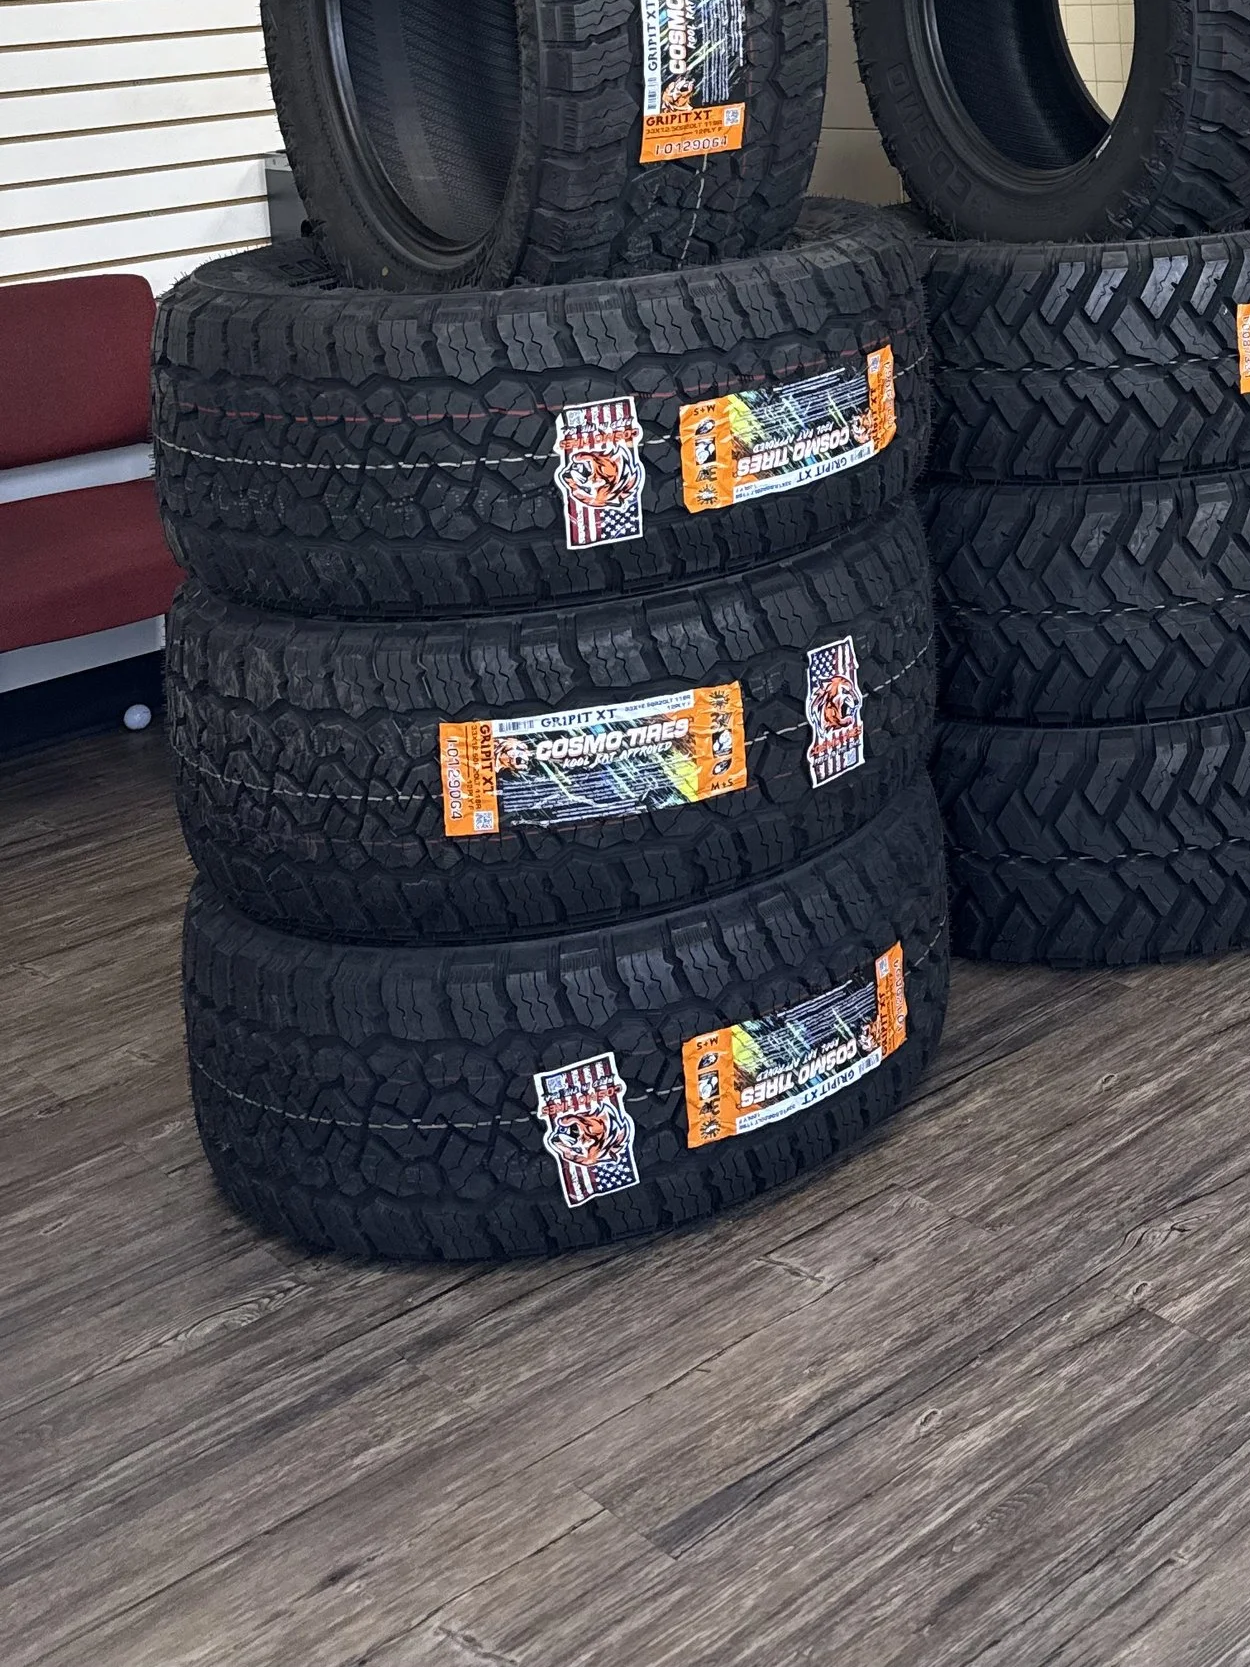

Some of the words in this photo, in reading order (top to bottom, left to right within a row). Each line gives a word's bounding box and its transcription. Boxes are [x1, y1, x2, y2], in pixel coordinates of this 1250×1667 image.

[646, 0, 658, 20] XT
[647, 22, 658, 72] GRIPIT
[646, 112, 692, 127] GRIPIT
[692, 110, 712, 122] XT
[793, 426, 850, 461] COSMO
[736, 448, 790, 477] TIRES
[814, 458, 848, 478] GRIPIT
[796, 467, 813, 483] XT
[540, 710, 594, 729] GRIPIT
[595, 708, 618, 722] XT
[479, 724, 494, 772] GRIPIT
[535, 732, 626, 762] COSMO
[629, 718, 690, 746] TIRES
[481, 776, 494, 797] XT
[697, 1036, 718, 1049] M+S
[797, 1039, 858, 1082] COSMO
[740, 1073, 794, 1108] TIRES
[818, 1069, 856, 1097] GRIPIT
[801, 1088, 818, 1105] XT
